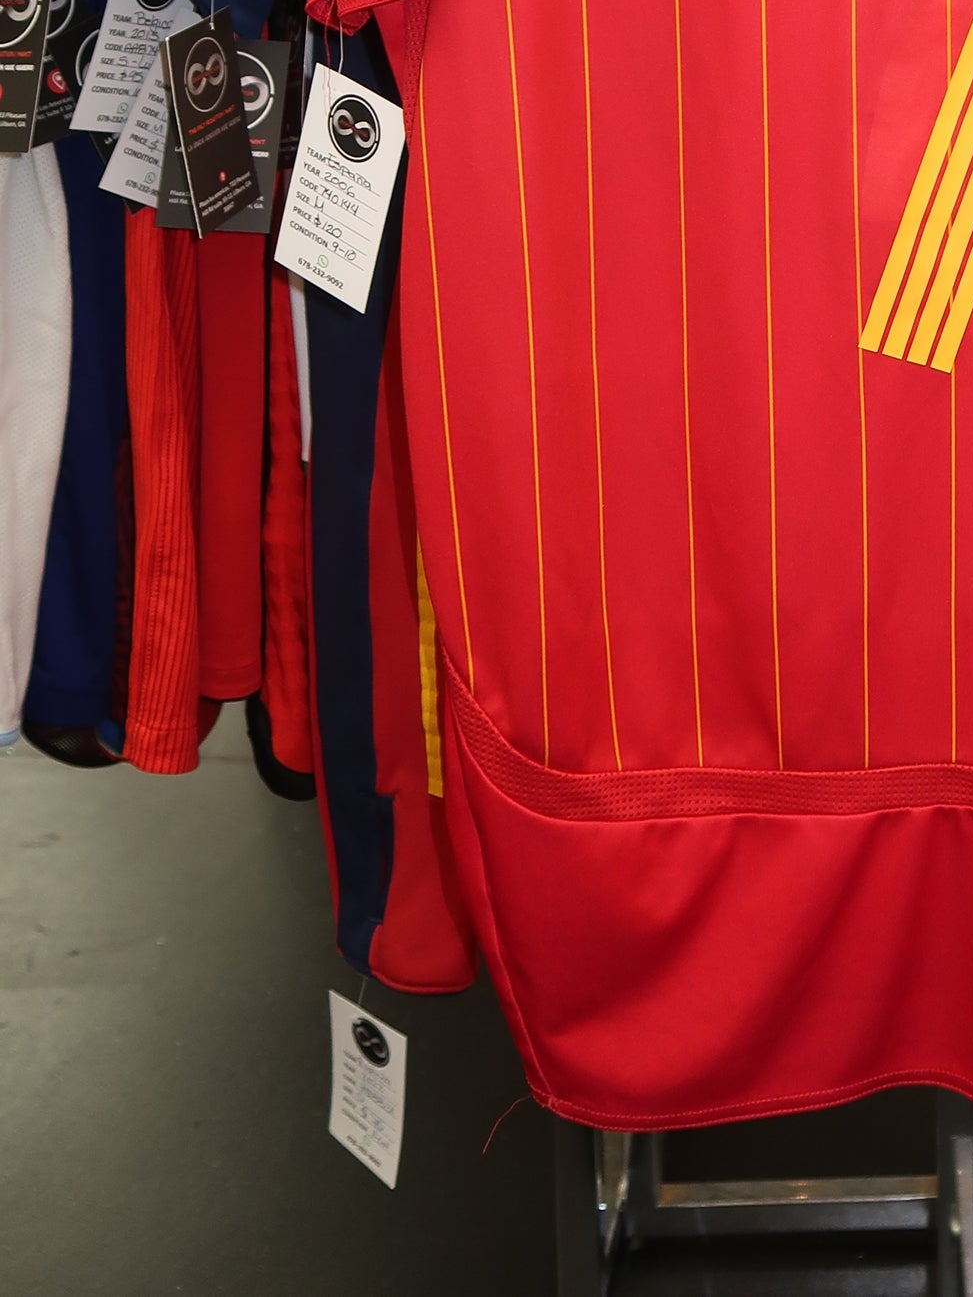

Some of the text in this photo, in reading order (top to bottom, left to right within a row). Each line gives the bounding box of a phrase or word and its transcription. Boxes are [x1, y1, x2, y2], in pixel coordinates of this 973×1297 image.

[113, 14, 132, 23] TEAM
[104, 43, 122, 53] CODE
[96, 72, 115, 80] PRICE
[91, 86, 130, 95] CONDITION
[148, 92, 164, 104] YEAR
[142, 106, 160, 118] CODE
[136, 120, 149, 129] SIZE
[130, 134, 148, 146] PRICE
[124, 146, 160, 165] CONDITION
[306, 147, 327, 164] TEAM
[300, 176, 318, 192] CODE
[303, 162, 355, 198] YEAR 2006
[296, 190, 310, 204] SIZE
[292, 206, 312, 222] PRICE
[290, 220, 357, 262] CONDITION 9-10
